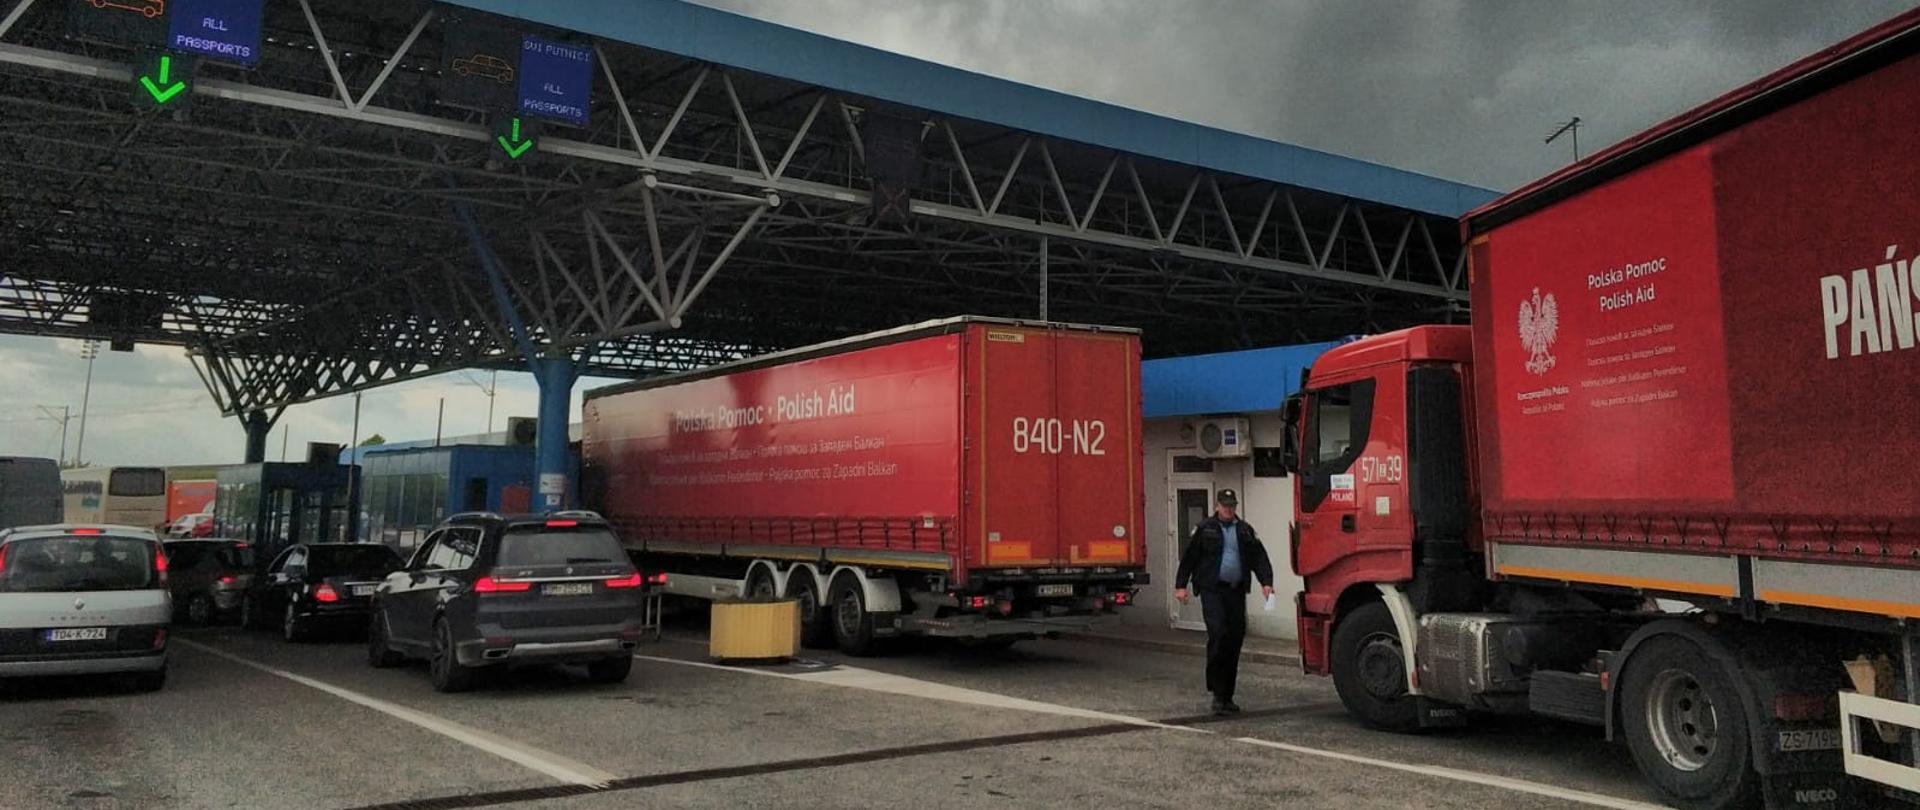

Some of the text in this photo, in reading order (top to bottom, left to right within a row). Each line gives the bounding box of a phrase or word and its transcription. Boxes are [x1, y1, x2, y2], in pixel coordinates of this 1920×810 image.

[203, 17, 228, 31] ALL
[176, 34, 250, 57] PASSPORTS
[544, 82, 564, 95] ALL
[524, 98, 582, 117] PASSPORTS
[1588, 256, 1667, 290] Polska Pomoc
[1600, 283, 1655, 312] Polish Aid
[675, 384, 854, 433] Polska Pomoc Polish Aid
[1013, 416, 1106, 455] 840-N2
[867, 459, 898, 477] Balkan
[1362, 456, 1380, 482] 571
[1387, 455, 1402, 482] 39
[1331, 492, 1354, 502] POLAND
[1795, 789, 1837, 802] IVECO
